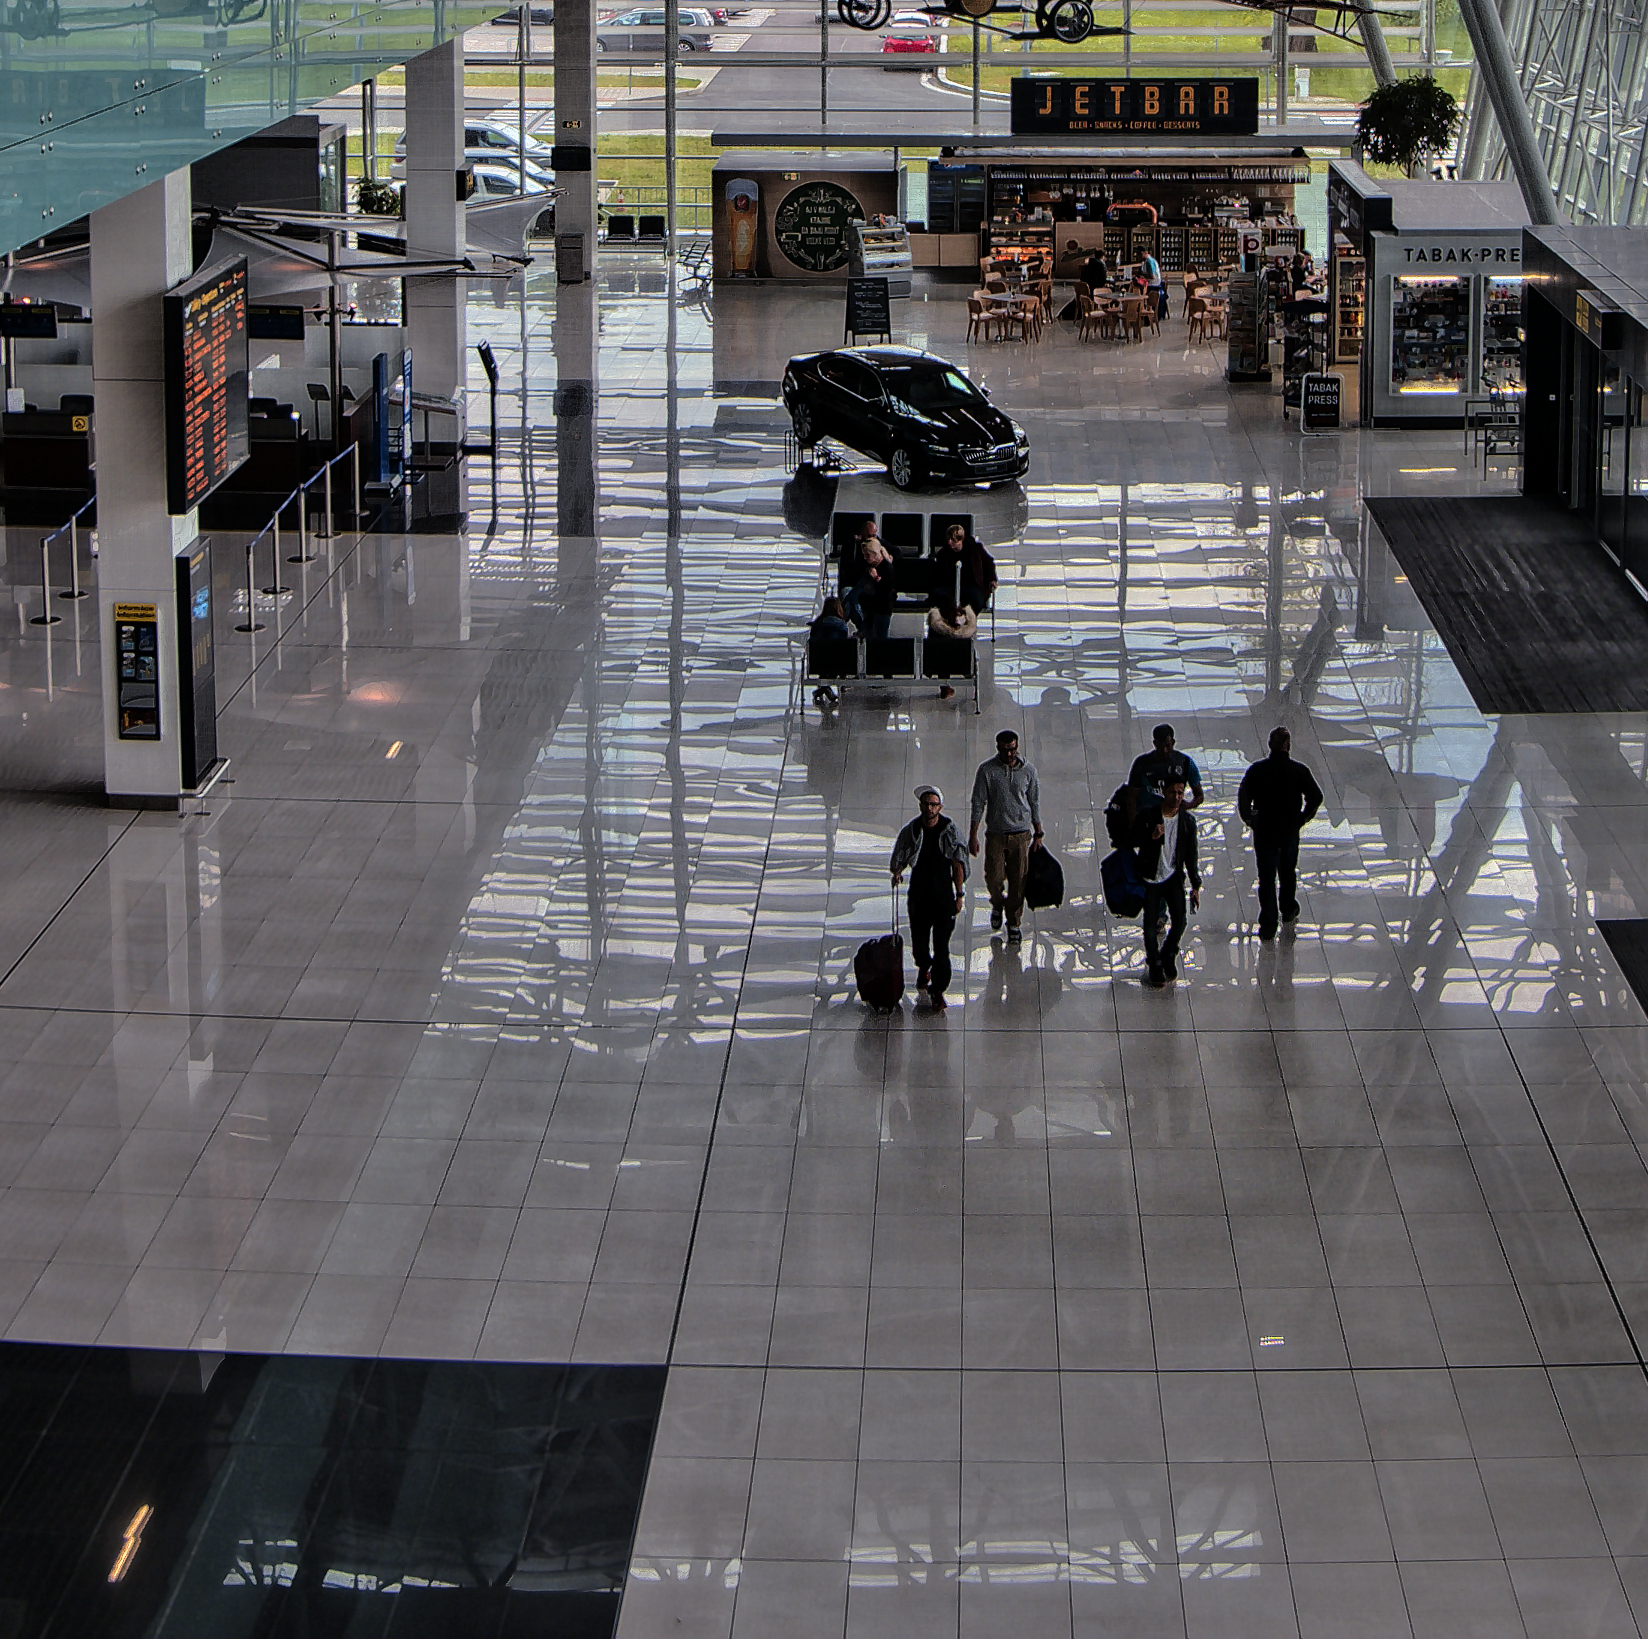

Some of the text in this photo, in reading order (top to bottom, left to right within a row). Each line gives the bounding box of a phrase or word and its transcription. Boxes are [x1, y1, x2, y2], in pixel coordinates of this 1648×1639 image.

[1038, 86, 1229, 115] JETBAR
[1308, 382, 1339, 393] TABAK
[1308, 395, 1338, 405] PRESS
